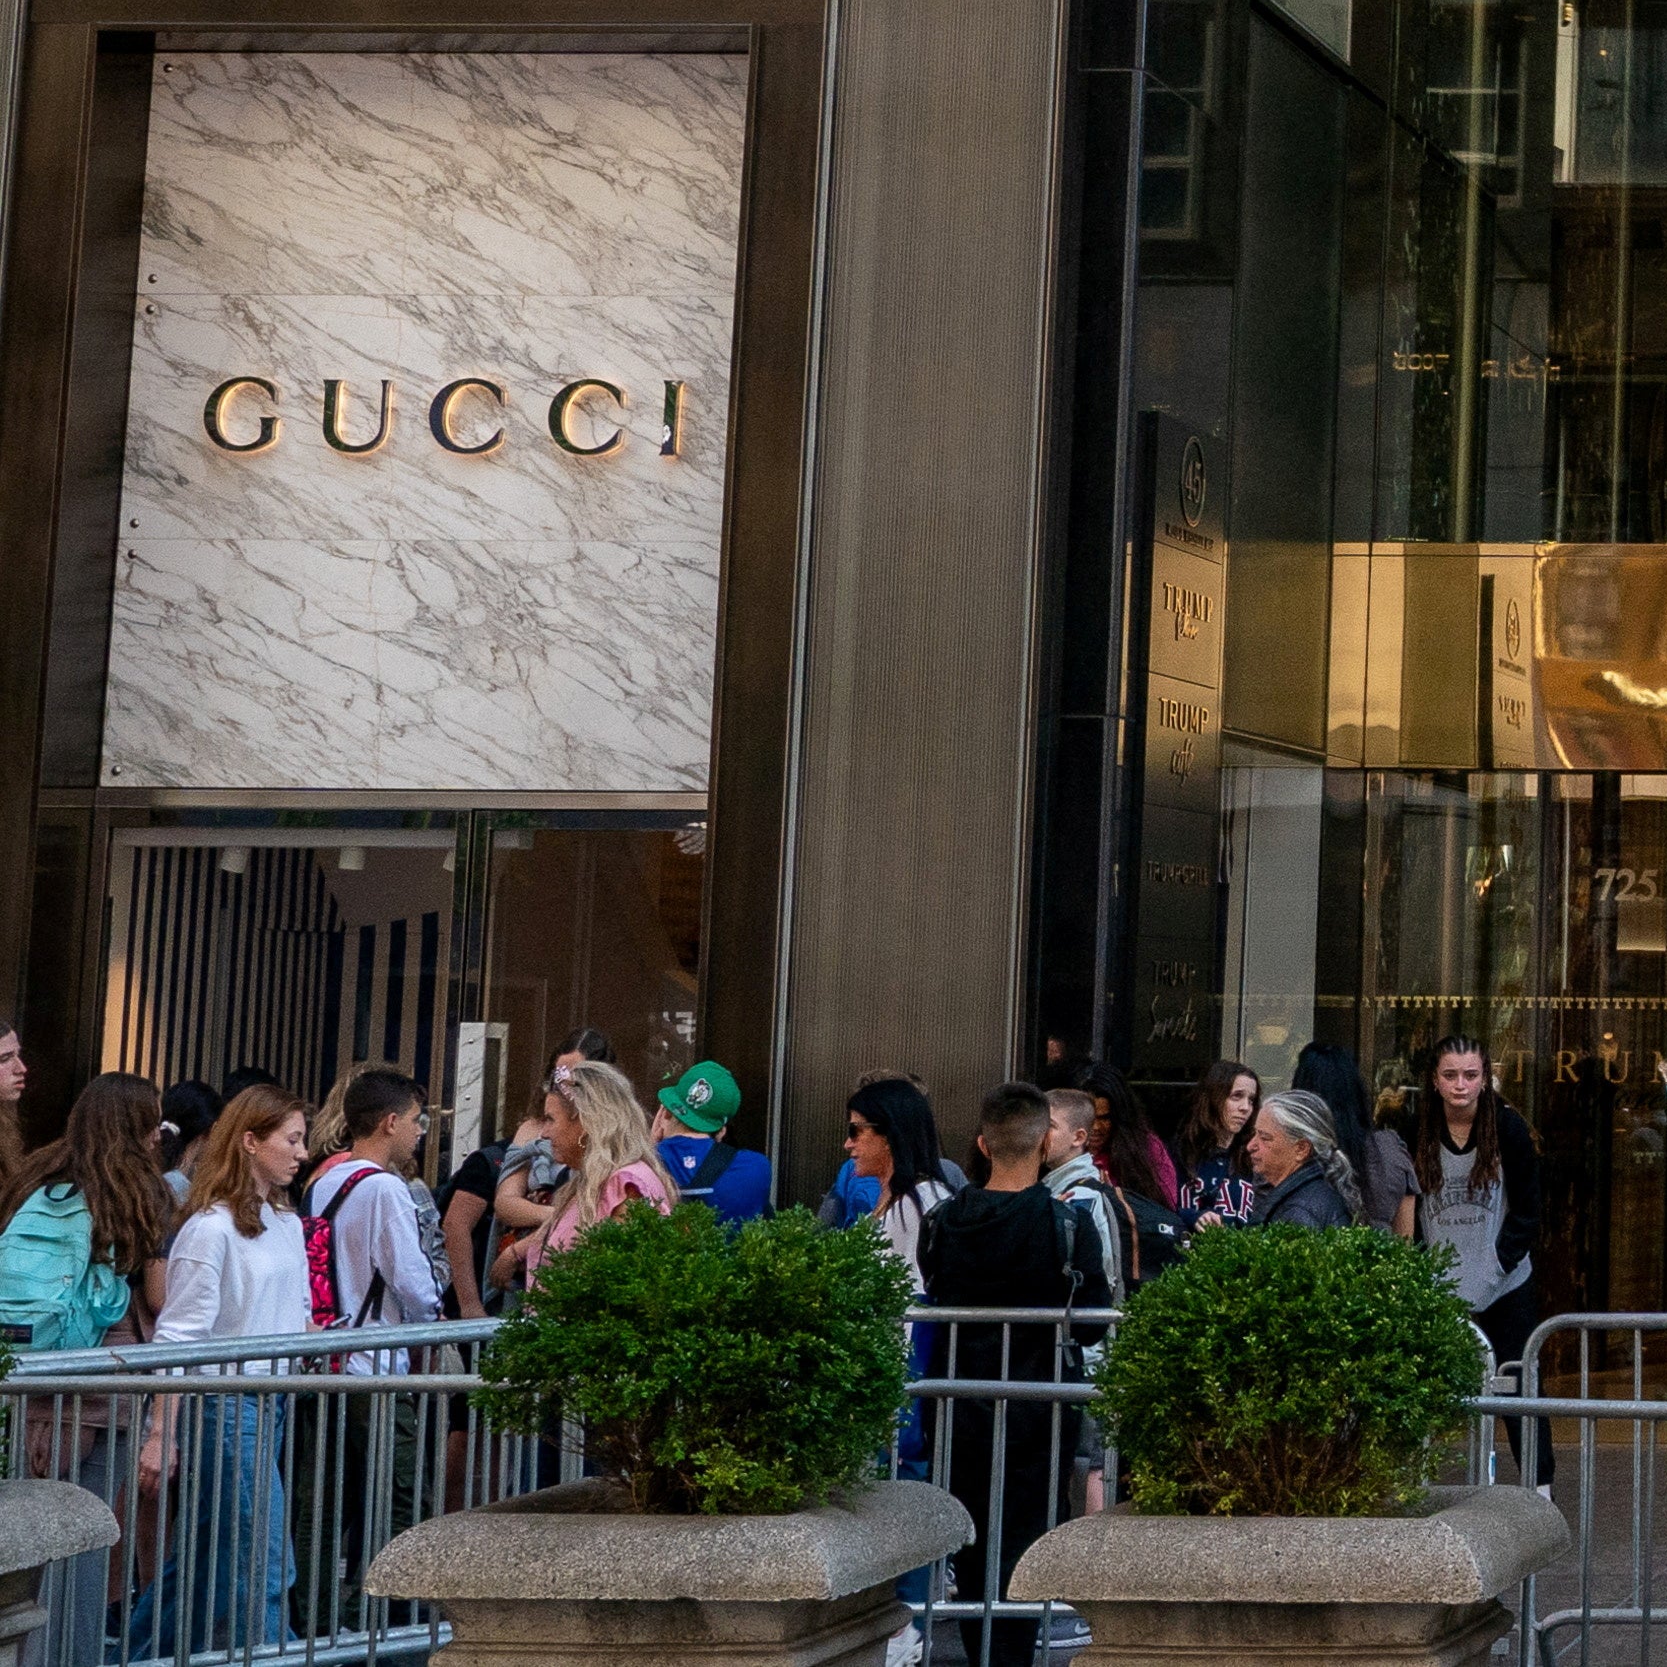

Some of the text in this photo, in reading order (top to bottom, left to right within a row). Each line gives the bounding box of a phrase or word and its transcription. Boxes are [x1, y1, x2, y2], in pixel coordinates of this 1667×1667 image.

[203, 375, 688, 457] GUCCI
[1163, 582, 1214, 623] TRUMP
[1159, 697, 1210, 735] TRUMP
[1595, 868, 1658, 902] 725
[1152, 960, 1197, 987] TRUMP
